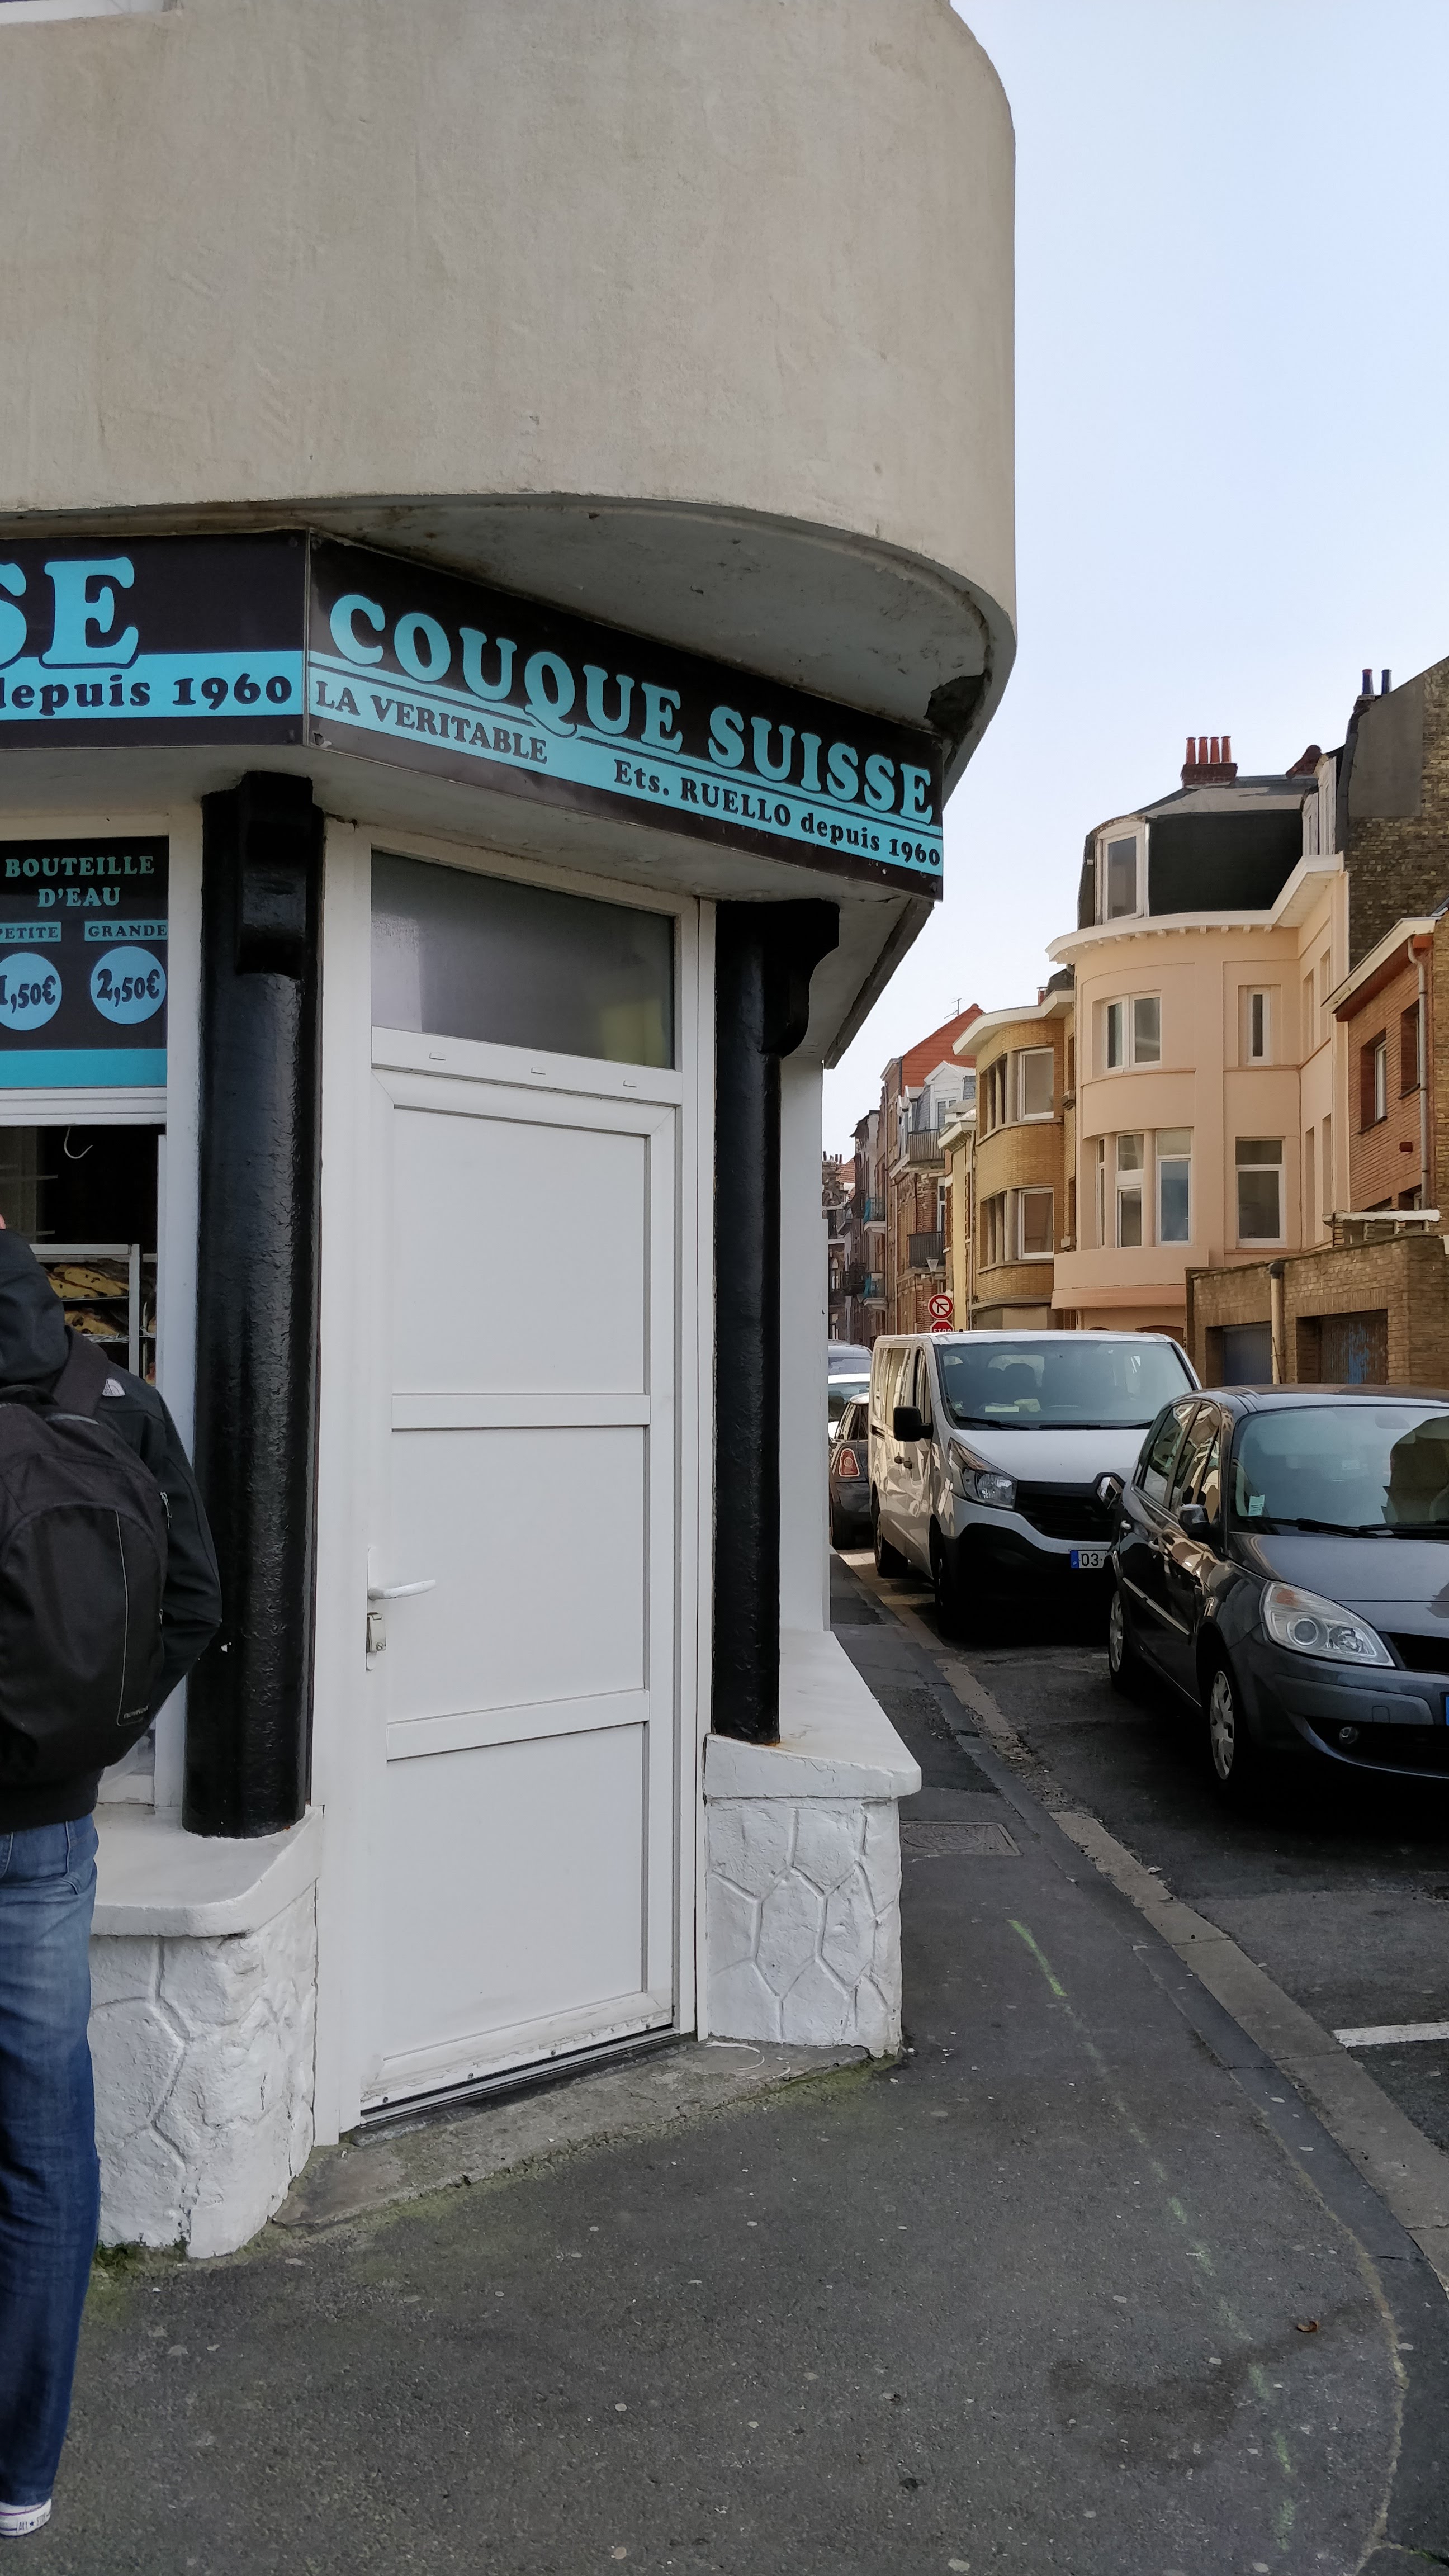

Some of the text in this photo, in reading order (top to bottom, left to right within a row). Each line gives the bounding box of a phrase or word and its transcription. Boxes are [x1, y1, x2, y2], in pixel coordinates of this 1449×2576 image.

[0, 674, 292, 716] epuis 1960
[330, 594, 932, 825] COUQUE SUISSE
[315, 681, 548, 764] LA VERITABLE
[614, 759, 940, 866] Ets. RUELLO depuis 1960
[5, 856, 154, 877] BOUTEILLE
[37, 887, 121, 907] D'EAU
[0, 927, 58, 939] ETITE
[88, 925, 167, 937] GRANDE
[96, 969, 161, 1007] 2,50€
